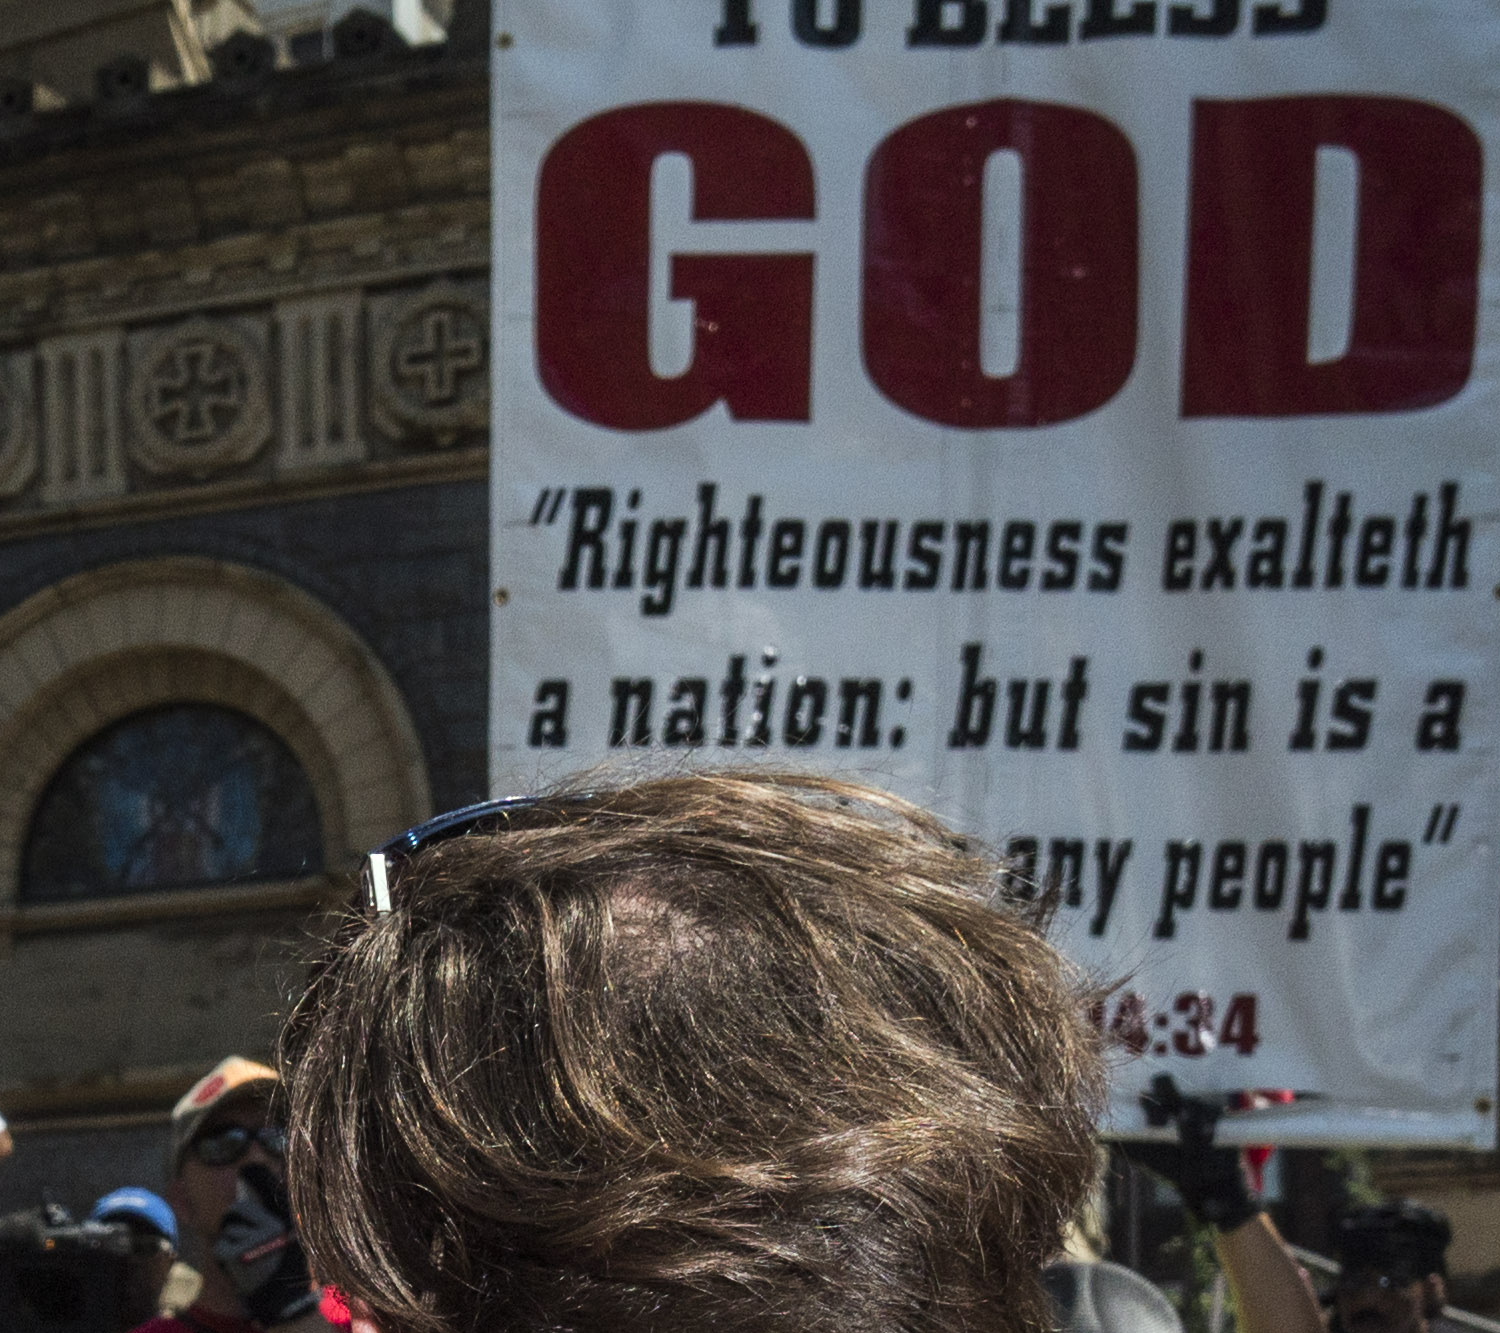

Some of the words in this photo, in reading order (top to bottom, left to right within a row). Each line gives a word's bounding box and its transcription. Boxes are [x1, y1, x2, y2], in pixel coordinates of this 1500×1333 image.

[532, 91, 1487, 433] GOD
[1162, 479, 1474, 595] exalteth
[528, 674, 571, 749] a
[610, 652, 914, 752] nation:
[948, 641, 1091, 752] but
[1123, 650, 1253, 754] sin
[1289, 646, 1379, 754] is
[1415, 677, 1470, 753] a
